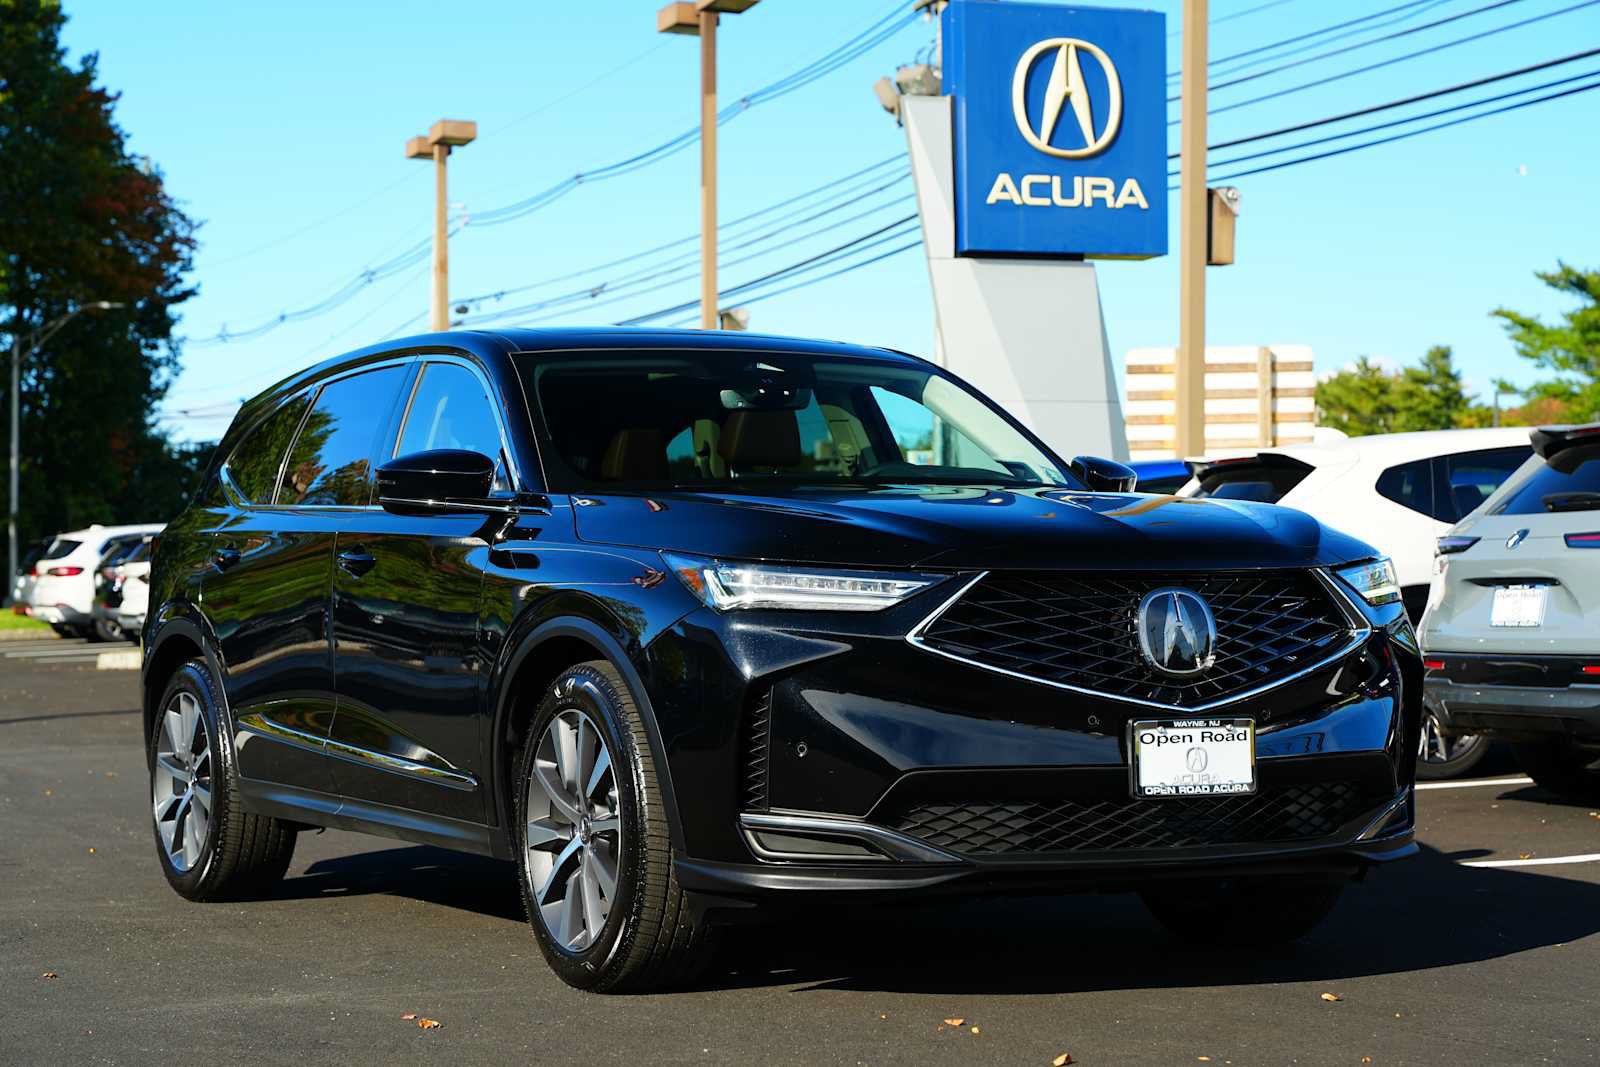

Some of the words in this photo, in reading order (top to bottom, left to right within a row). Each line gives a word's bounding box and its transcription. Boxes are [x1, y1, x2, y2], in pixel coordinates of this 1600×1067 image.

[986, 172, 1150, 209] ACURA
[1173, 720, 1207, 728] WAYNE,
[1140, 732, 1193, 747] Open
[1201, 730, 1247, 743] Road
[1145, 785, 1176, 795] OPEN
[1179, 785, 1211, 794] ROAD
[1213, 783, 1250, 793] ACURA
